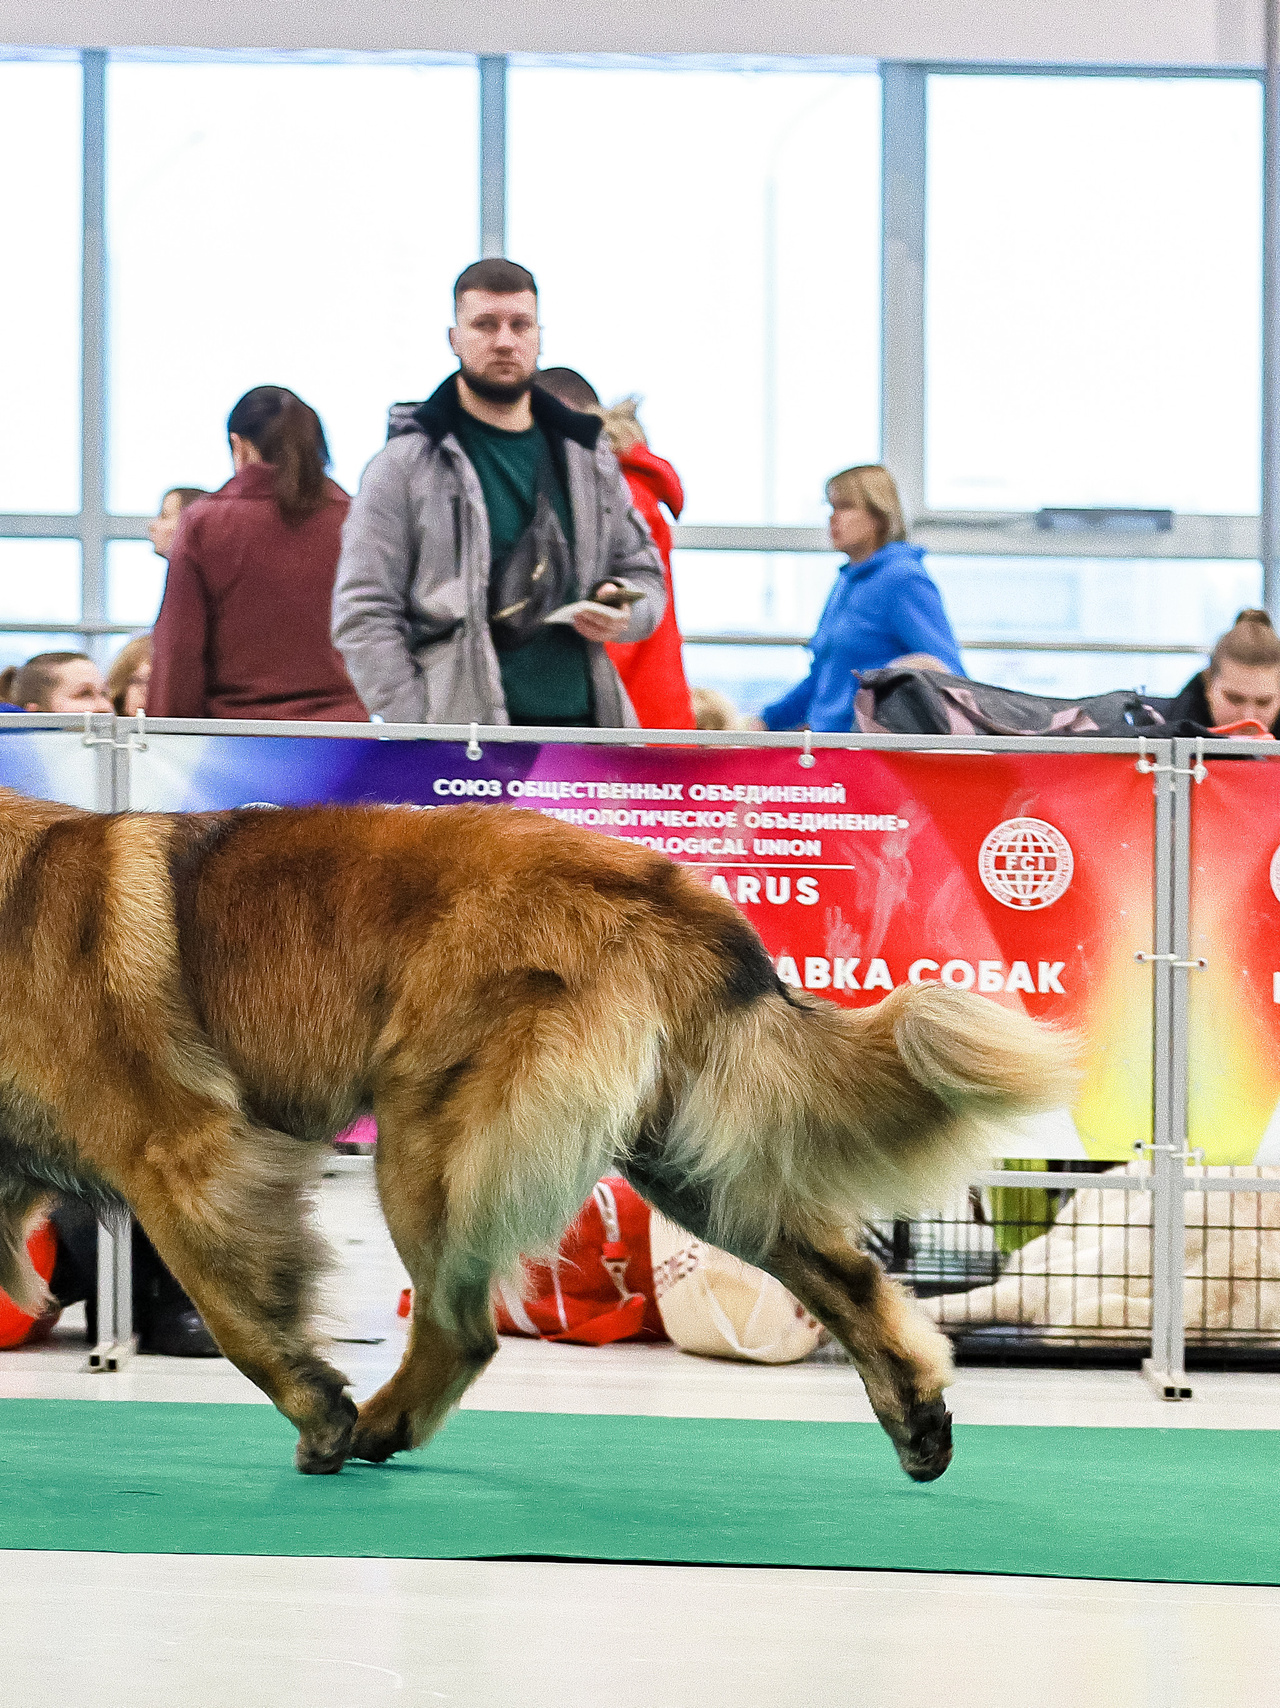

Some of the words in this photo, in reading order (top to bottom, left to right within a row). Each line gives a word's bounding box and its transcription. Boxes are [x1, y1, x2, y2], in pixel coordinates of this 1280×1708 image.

[433, 779, 503, 797] СОЮЗ
[507, 780, 684, 801] ОБЩЕСТВЕННЫХ
[688, 783, 847, 804] ОБЪЕДИНЕНИЙ
[744, 811, 910, 832] ОБЪЕДИНЕНИЕ»
[753, 838, 822, 857] UNION
[1005, 856, 1046, 870] FCI
[908, 958, 1066, 994] СОБАК
